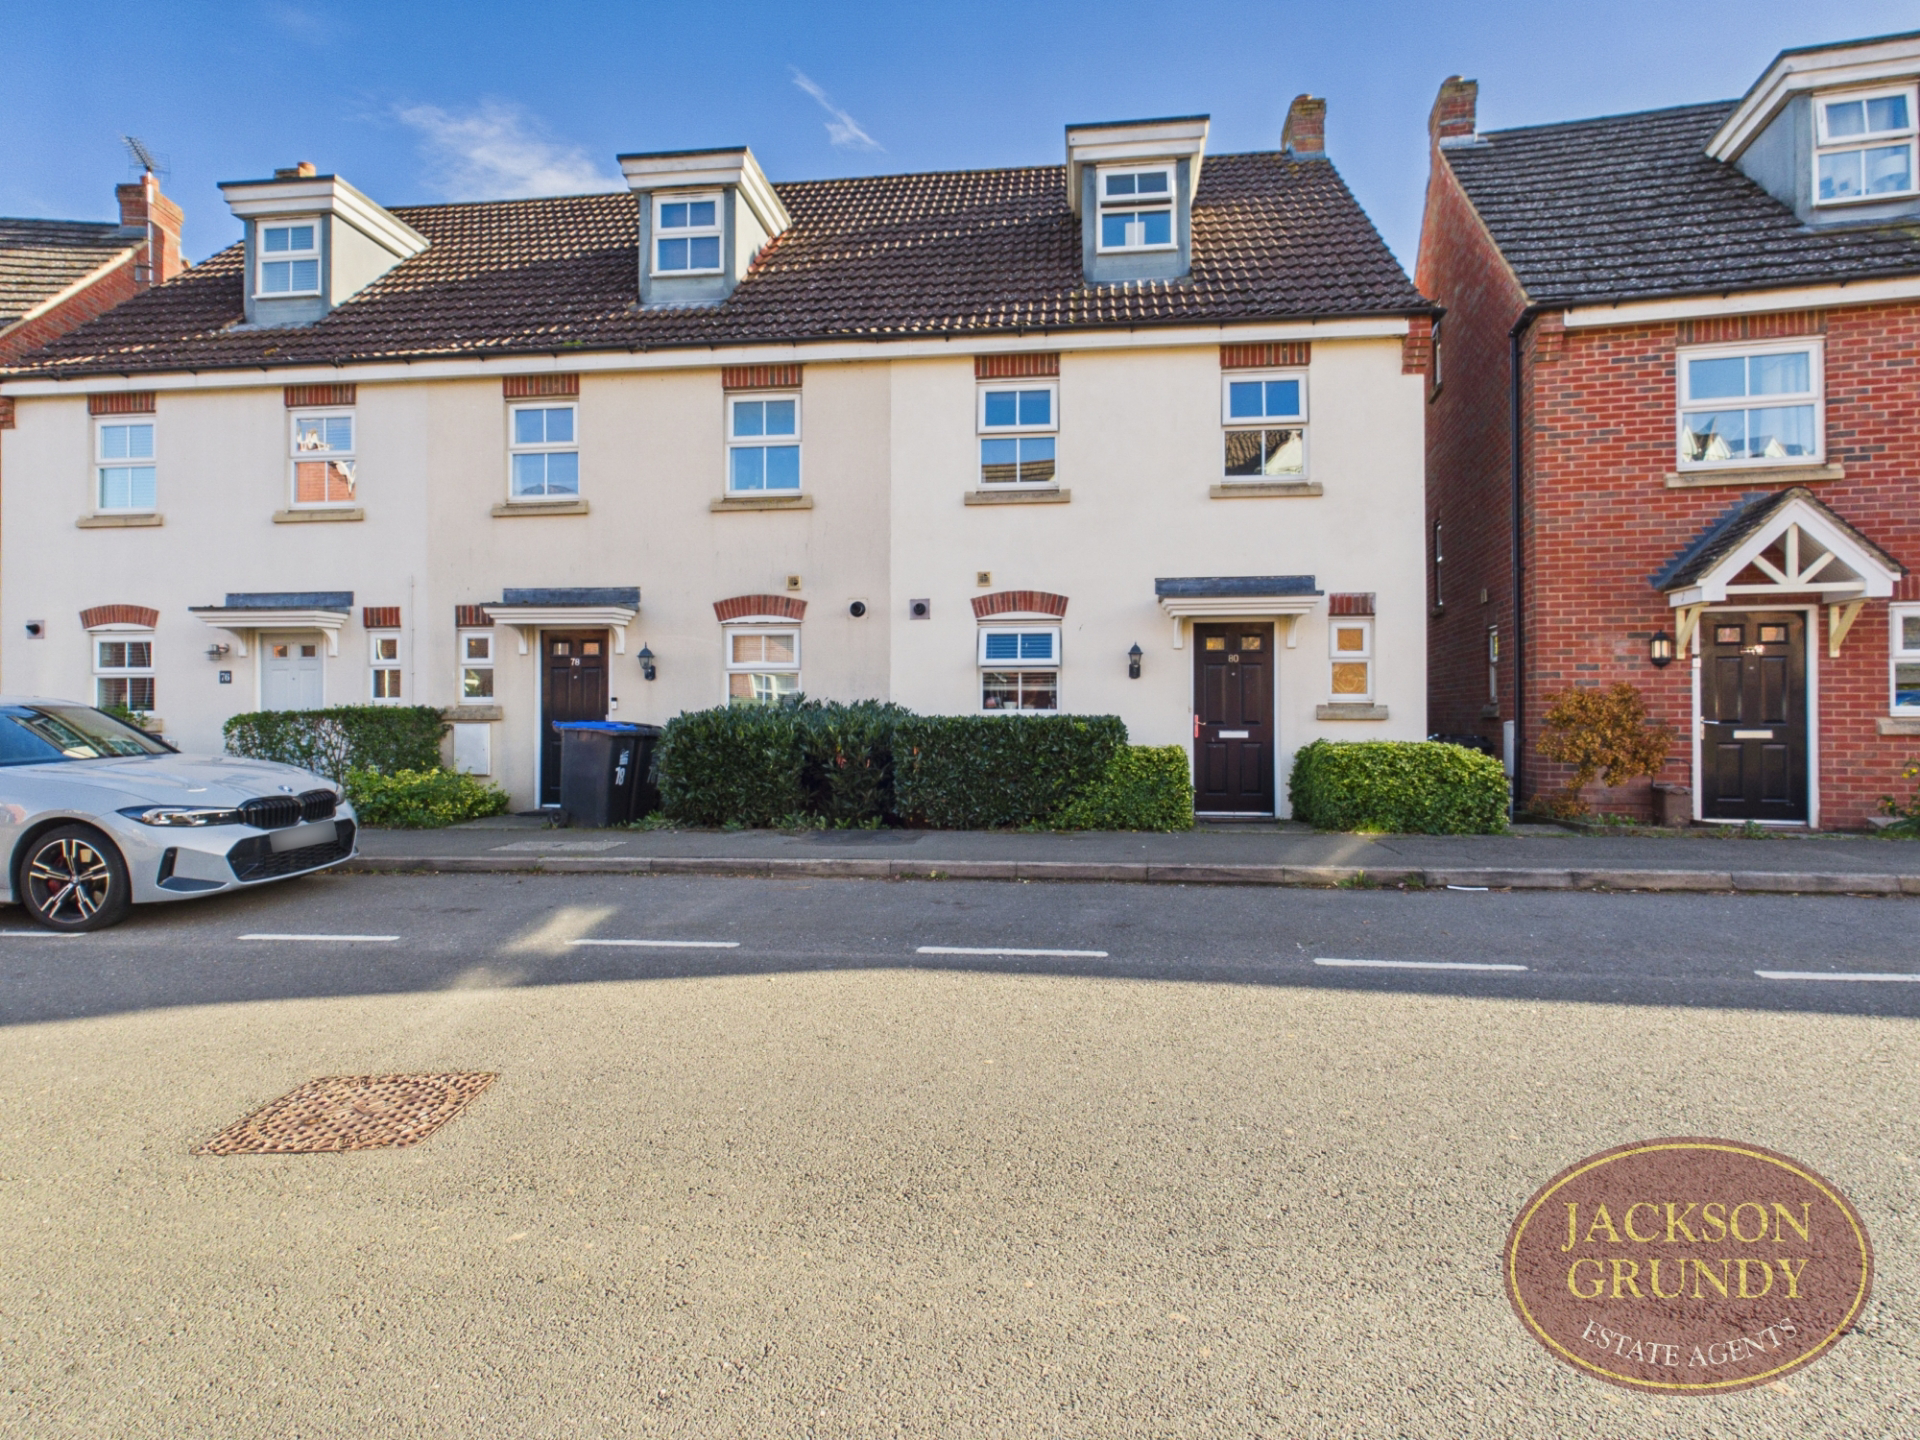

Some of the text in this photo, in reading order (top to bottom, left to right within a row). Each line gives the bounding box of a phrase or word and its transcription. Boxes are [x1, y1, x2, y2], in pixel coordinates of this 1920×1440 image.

[570, 658, 580, 666] 78
[1228, 654, 1239, 662] 80
[220, 672, 230, 681] 76
[615, 766, 625, 785] 78
